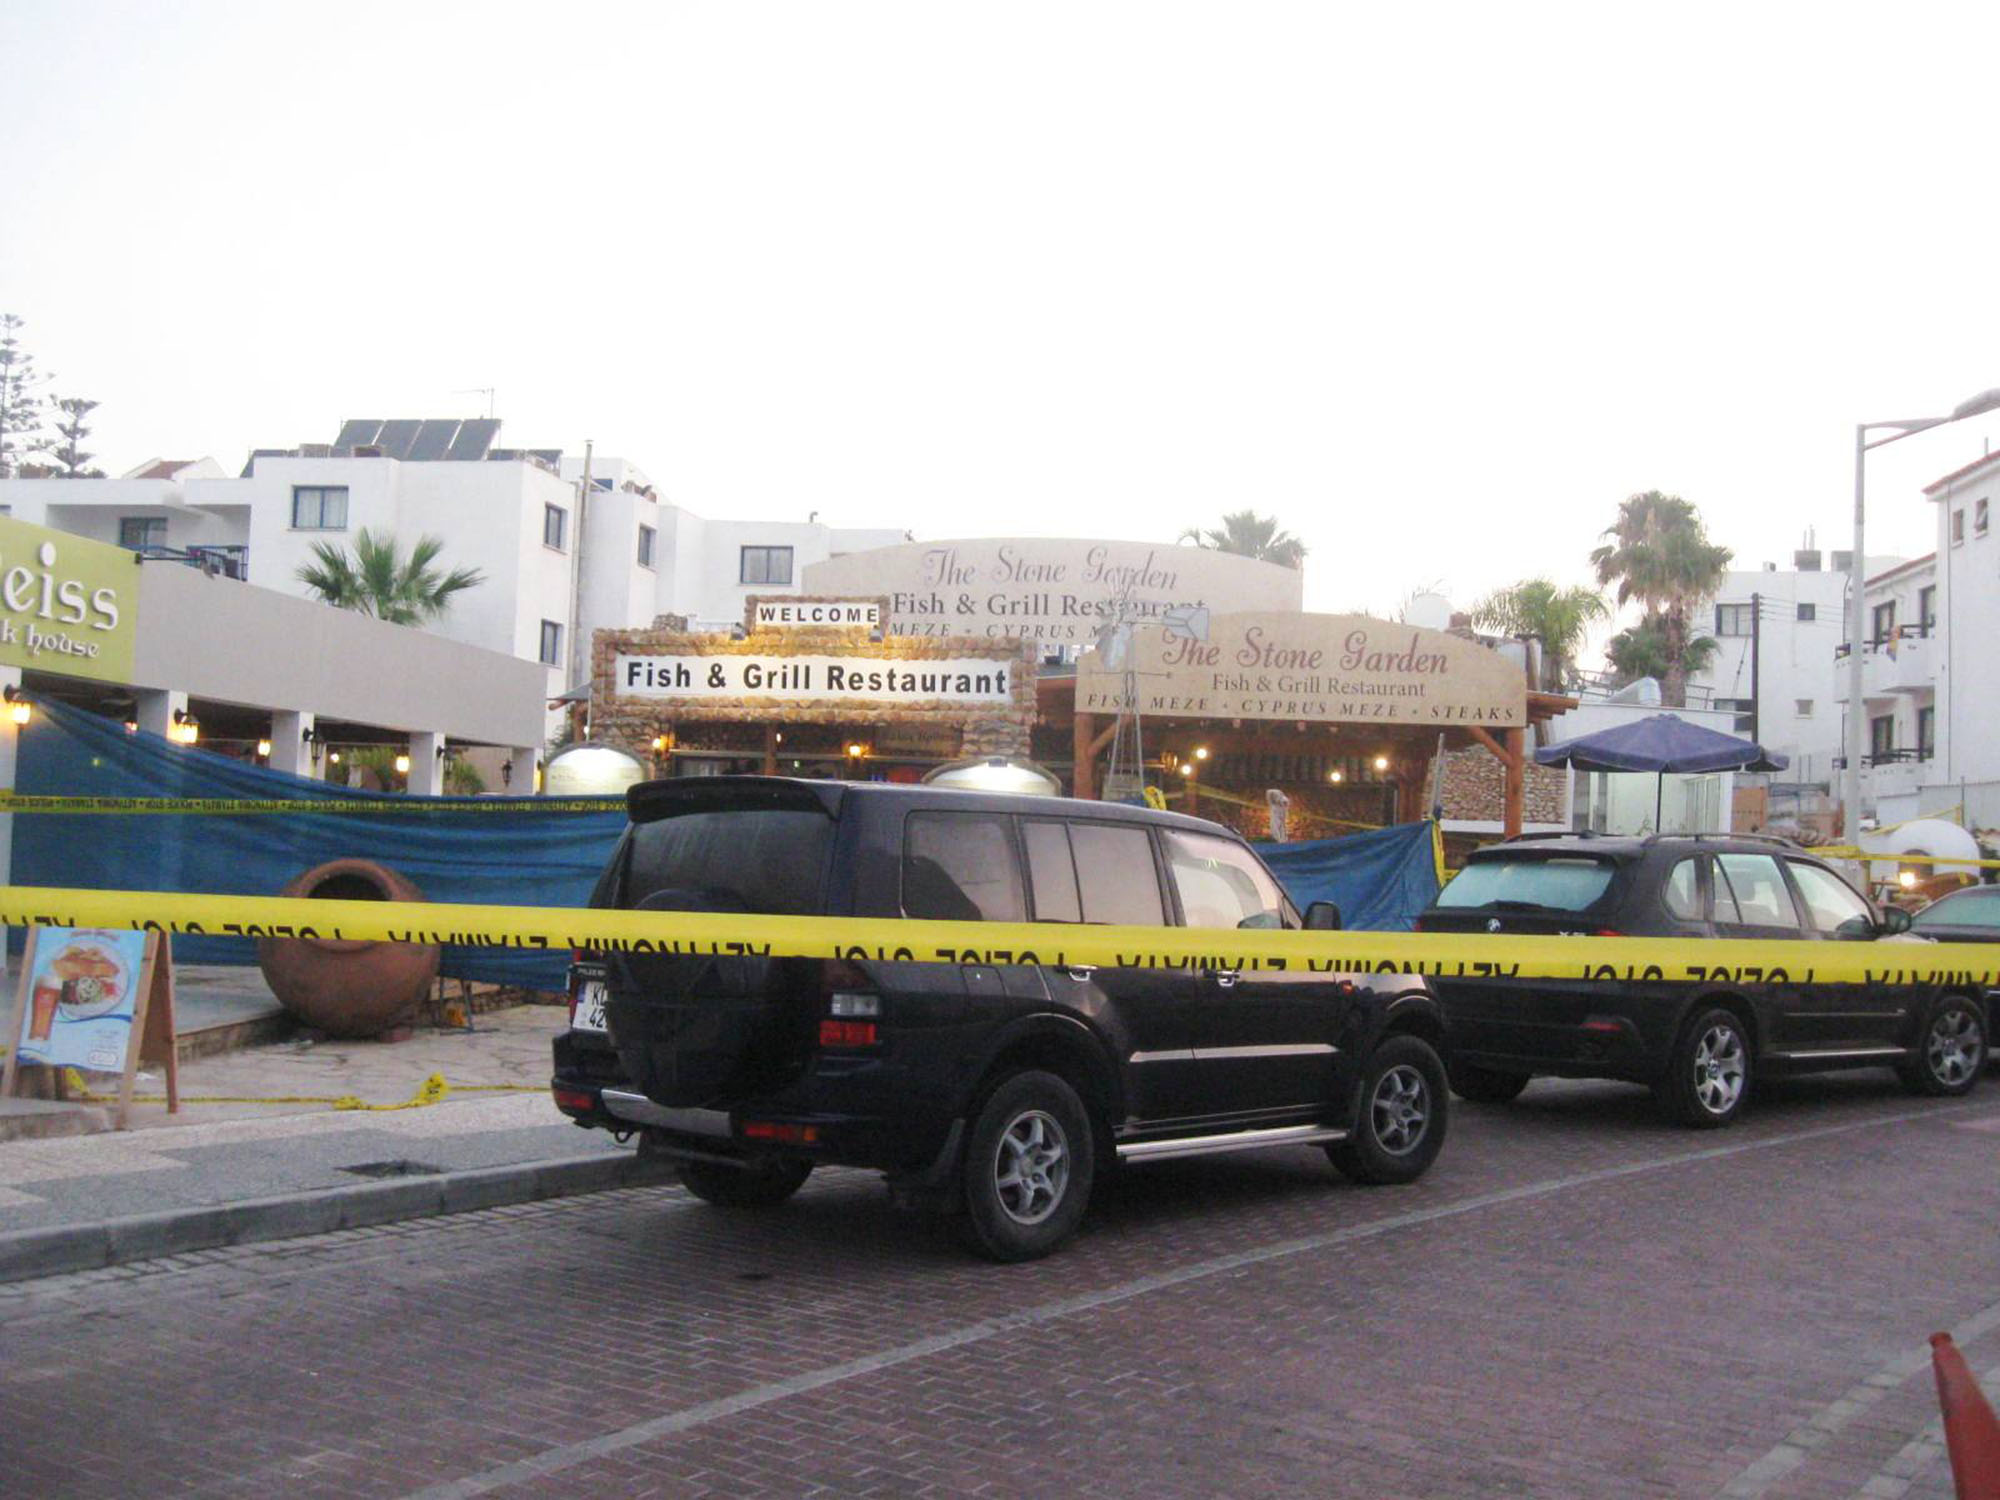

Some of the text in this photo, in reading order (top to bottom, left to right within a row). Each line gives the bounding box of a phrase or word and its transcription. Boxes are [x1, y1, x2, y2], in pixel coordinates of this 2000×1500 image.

[923, 545, 1178, 590] The Stone Garden
[3, 541, 120, 631] eiss
[760, 606, 878, 623] WELCOME
[893, 592, 945, 614] Fish
[956, 593, 976, 615] &
[988, 594, 1049, 615] Grill
[26, 623, 100, 657] house
[890, 623, 951, 637] MEZE
[986, 624, 1075, 639] CYPRUS
[1162, 626, 1448, 674] The Stone Garden
[627, 661, 1007, 694] Fish & Grill Restaurant
[1213, 673, 1426, 698] Fish & Grill Restaurant
[1151, 697, 1209, 711] MEZE
[1242, 700, 1326, 715] CYPRUS
[1340, 702, 1398, 717] MEZE
[1431, 705, 1515, 720] STEAKS
